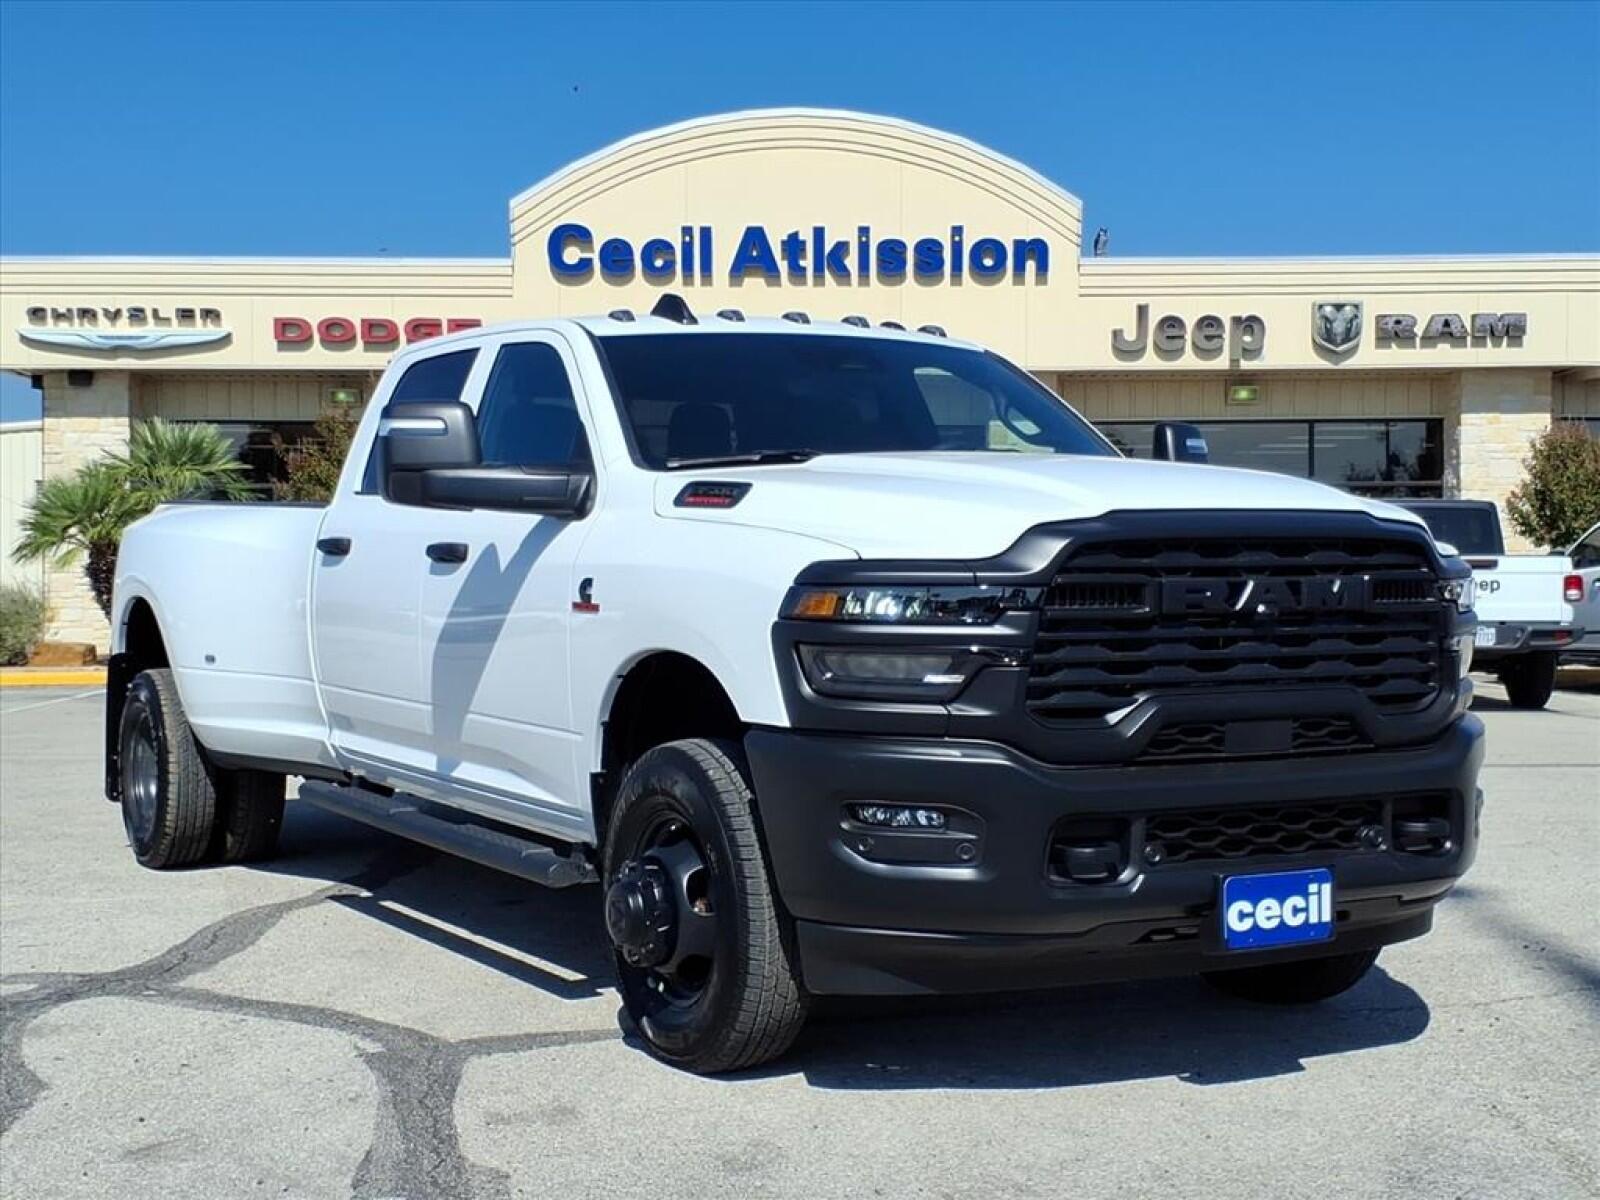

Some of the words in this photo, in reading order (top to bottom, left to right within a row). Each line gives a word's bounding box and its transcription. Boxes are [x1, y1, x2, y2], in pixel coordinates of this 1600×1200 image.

[546, 222, 713, 281] Cecil
[729, 224, 1050, 281] Atkission
[26, 306, 222, 326] CHRYSLER
[1111, 303, 1266, 364] Jeep
[1375, 312, 1528, 343] RAM
[1161, 575, 1366, 614] RAM
[1475, 580, 1501, 594] ep
[1227, 882, 1332, 932] cecil
